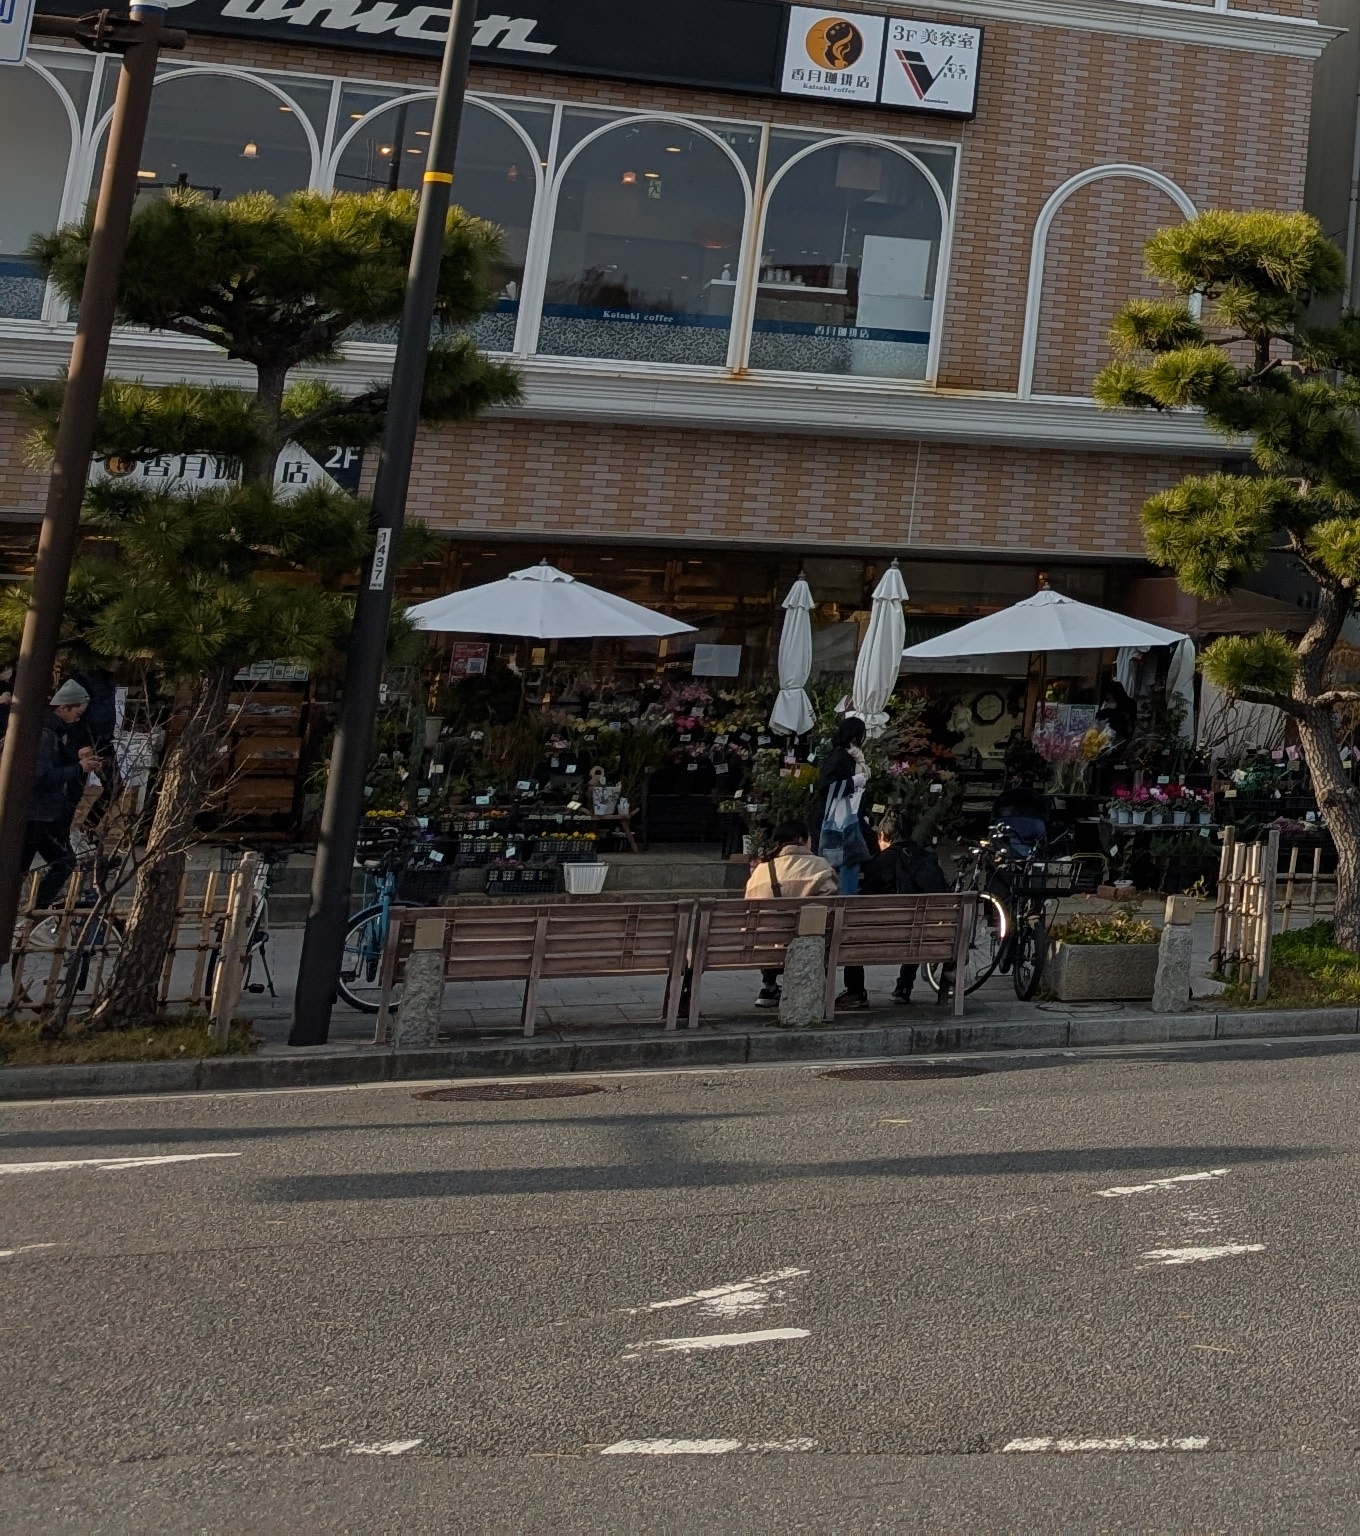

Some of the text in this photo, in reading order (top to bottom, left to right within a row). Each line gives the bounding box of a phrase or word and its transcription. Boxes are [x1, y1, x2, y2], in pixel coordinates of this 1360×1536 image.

[893, 24, 975, 50] 3F 美容室
[602, 310, 674, 324] Katsuki coffee
[324, 445, 360, 469] 2F
[373, 531, 388, 580] 1437
